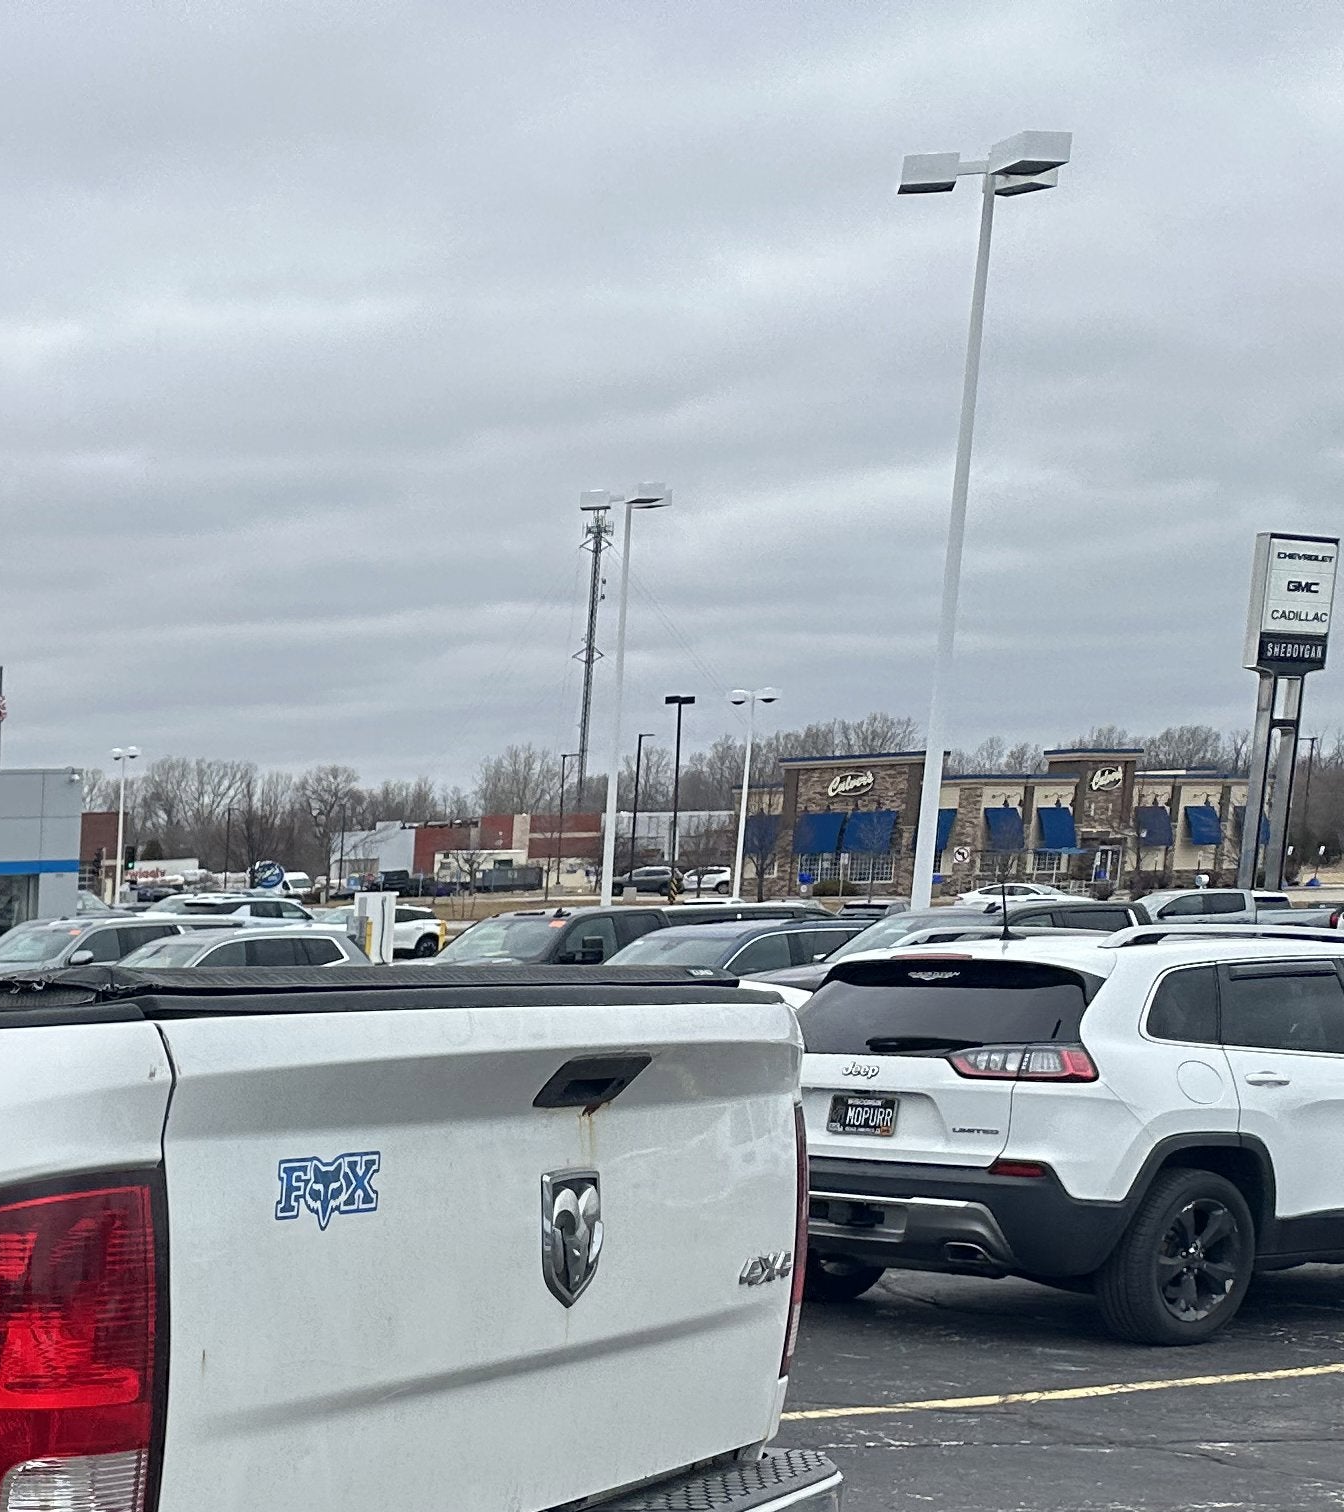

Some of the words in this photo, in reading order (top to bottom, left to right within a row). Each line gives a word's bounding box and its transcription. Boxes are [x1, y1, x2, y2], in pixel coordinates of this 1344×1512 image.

[1277, 552, 1334, 562] CHEVROLET
[1287, 580, 1320, 593] GMC
[1271, 609, 1328, 622] CADILLAC
[1267, 643, 1323, 658] SHEBOYGAN
[842, 1061, 880, 1079] Jeep
[846, 1106, 892, 1126] MOPURR
[952, 1127, 1000, 1135] LIMITED
